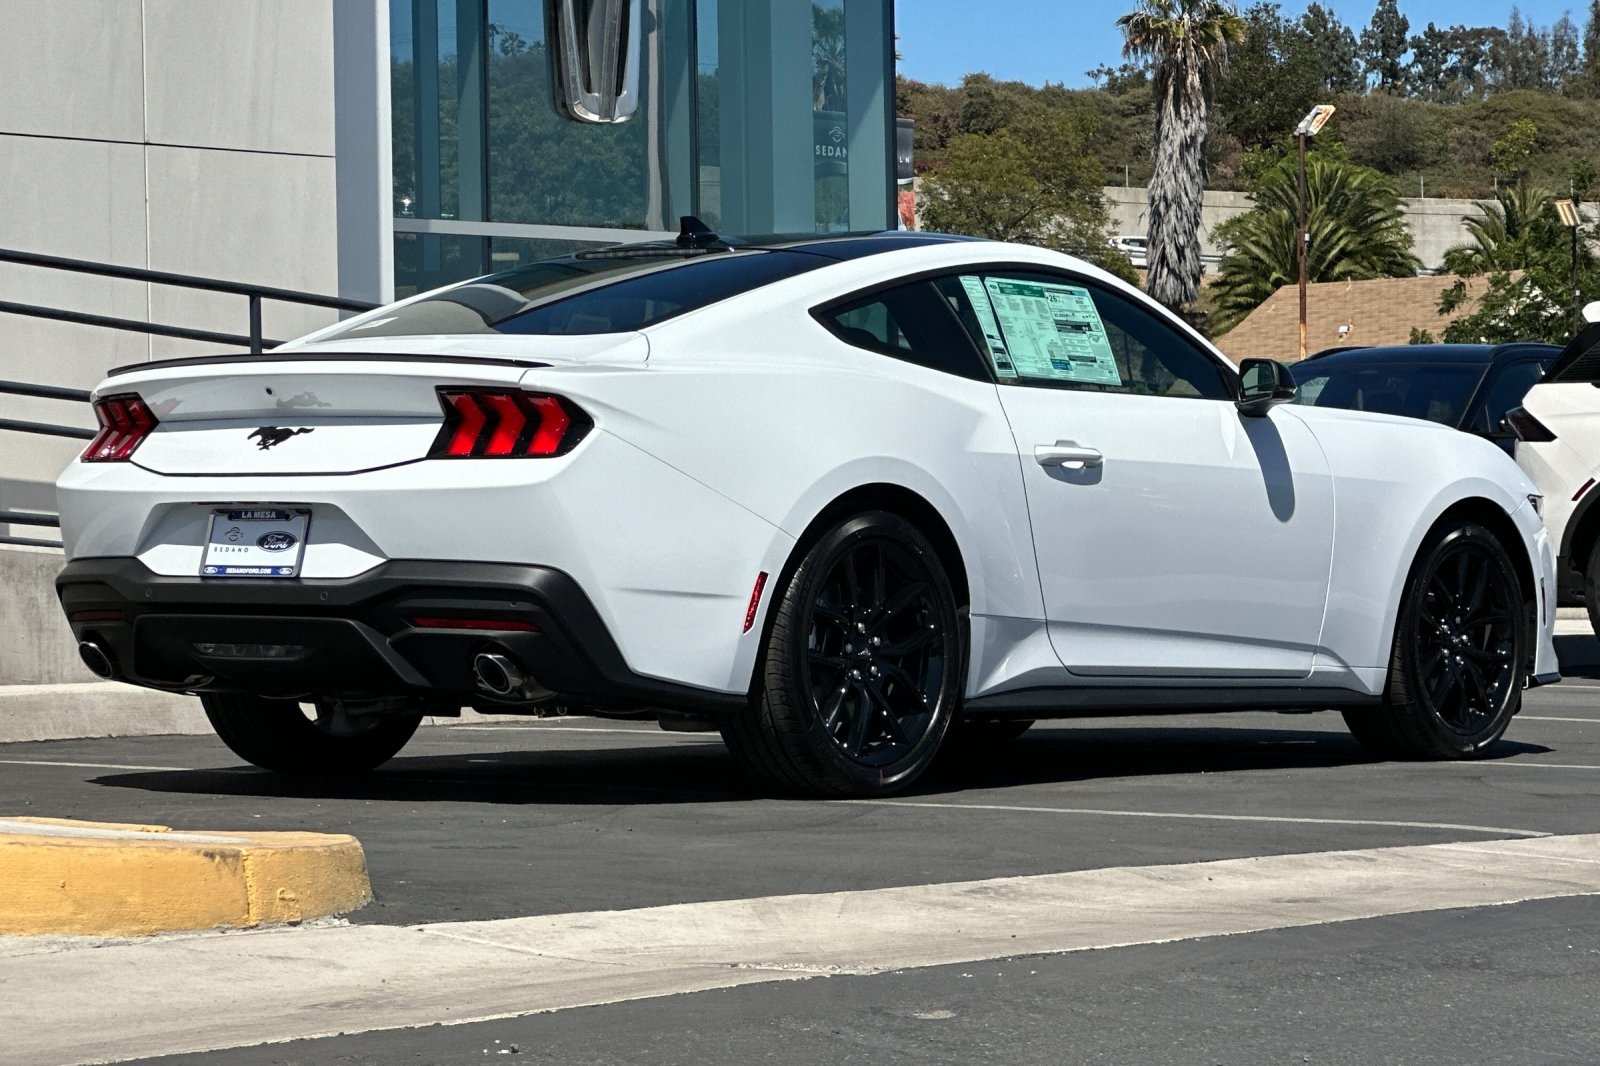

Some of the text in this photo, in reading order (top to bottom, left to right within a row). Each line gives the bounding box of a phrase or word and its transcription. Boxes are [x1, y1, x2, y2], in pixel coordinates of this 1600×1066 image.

[241, 511, 276, 519] LA MESA
[263, 534, 290, 549] Ford
